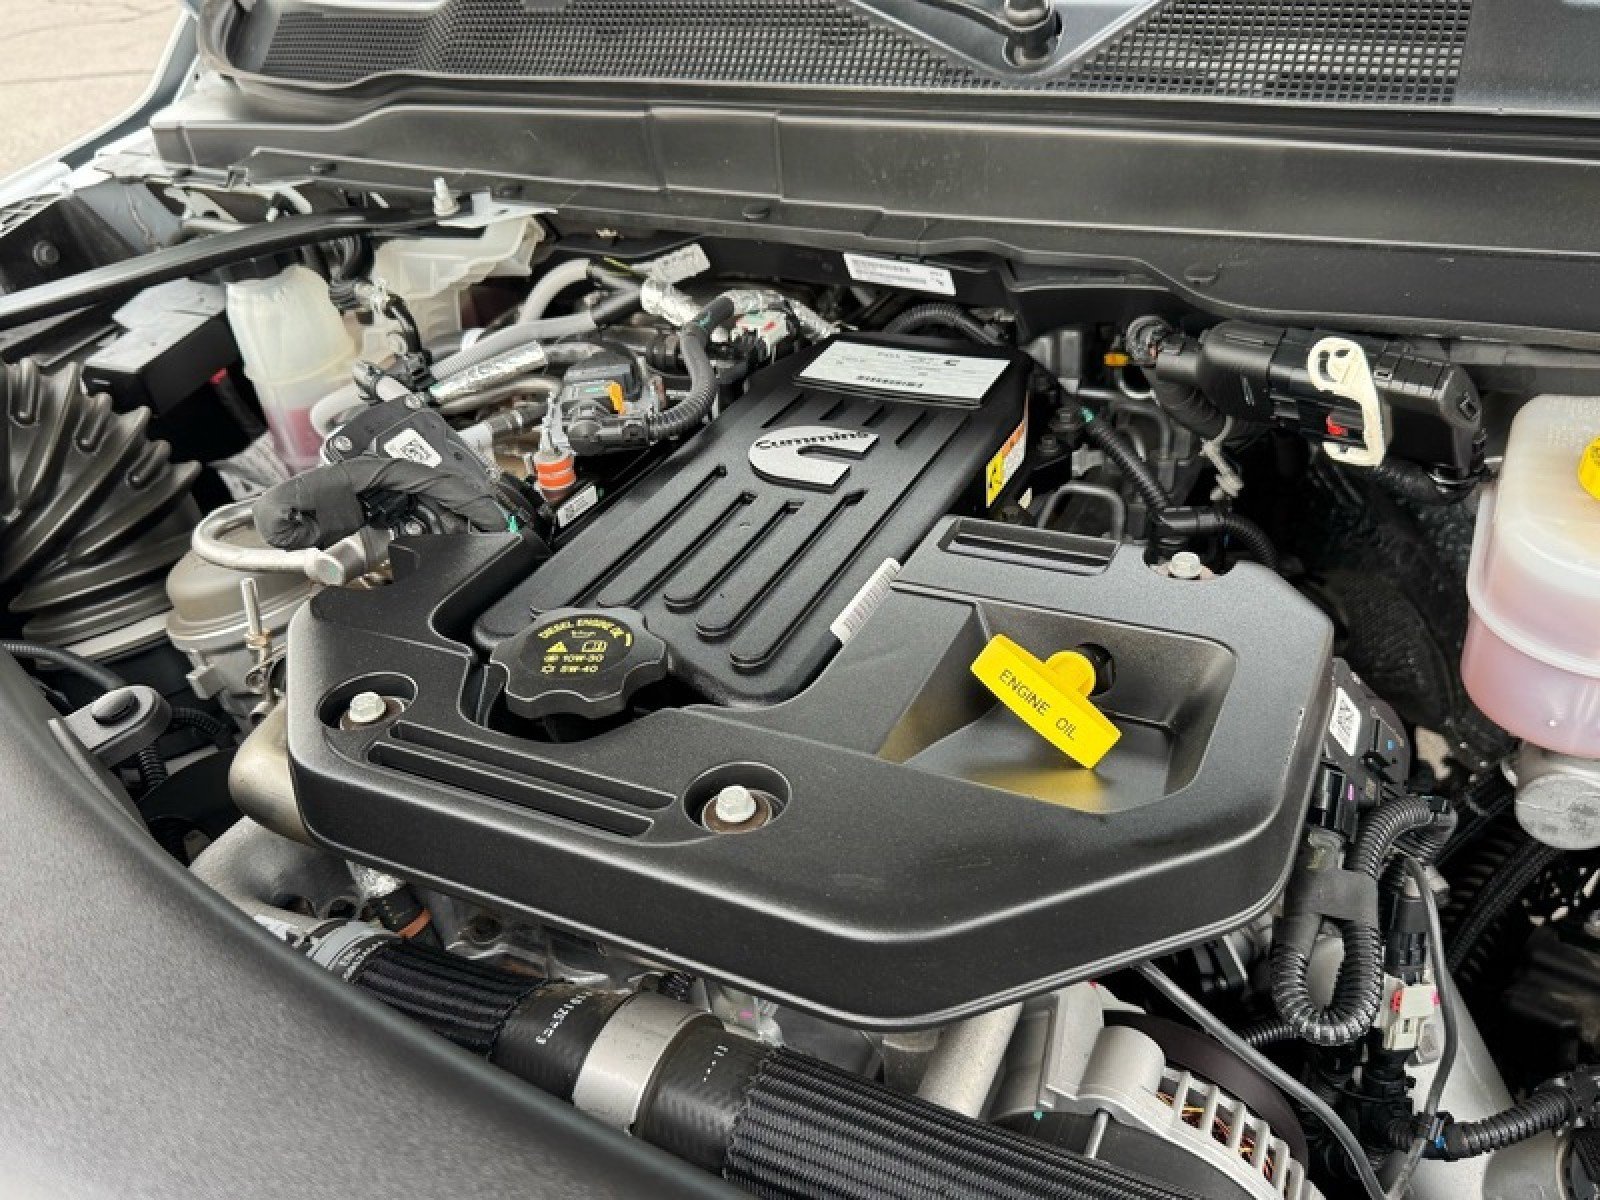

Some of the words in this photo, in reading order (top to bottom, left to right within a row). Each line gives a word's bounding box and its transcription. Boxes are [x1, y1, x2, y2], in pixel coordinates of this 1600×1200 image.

[755, 431, 869, 450] Cummins
[999, 669, 1050, 716] ENGINE
[1055, 717, 1077, 741] OIL
